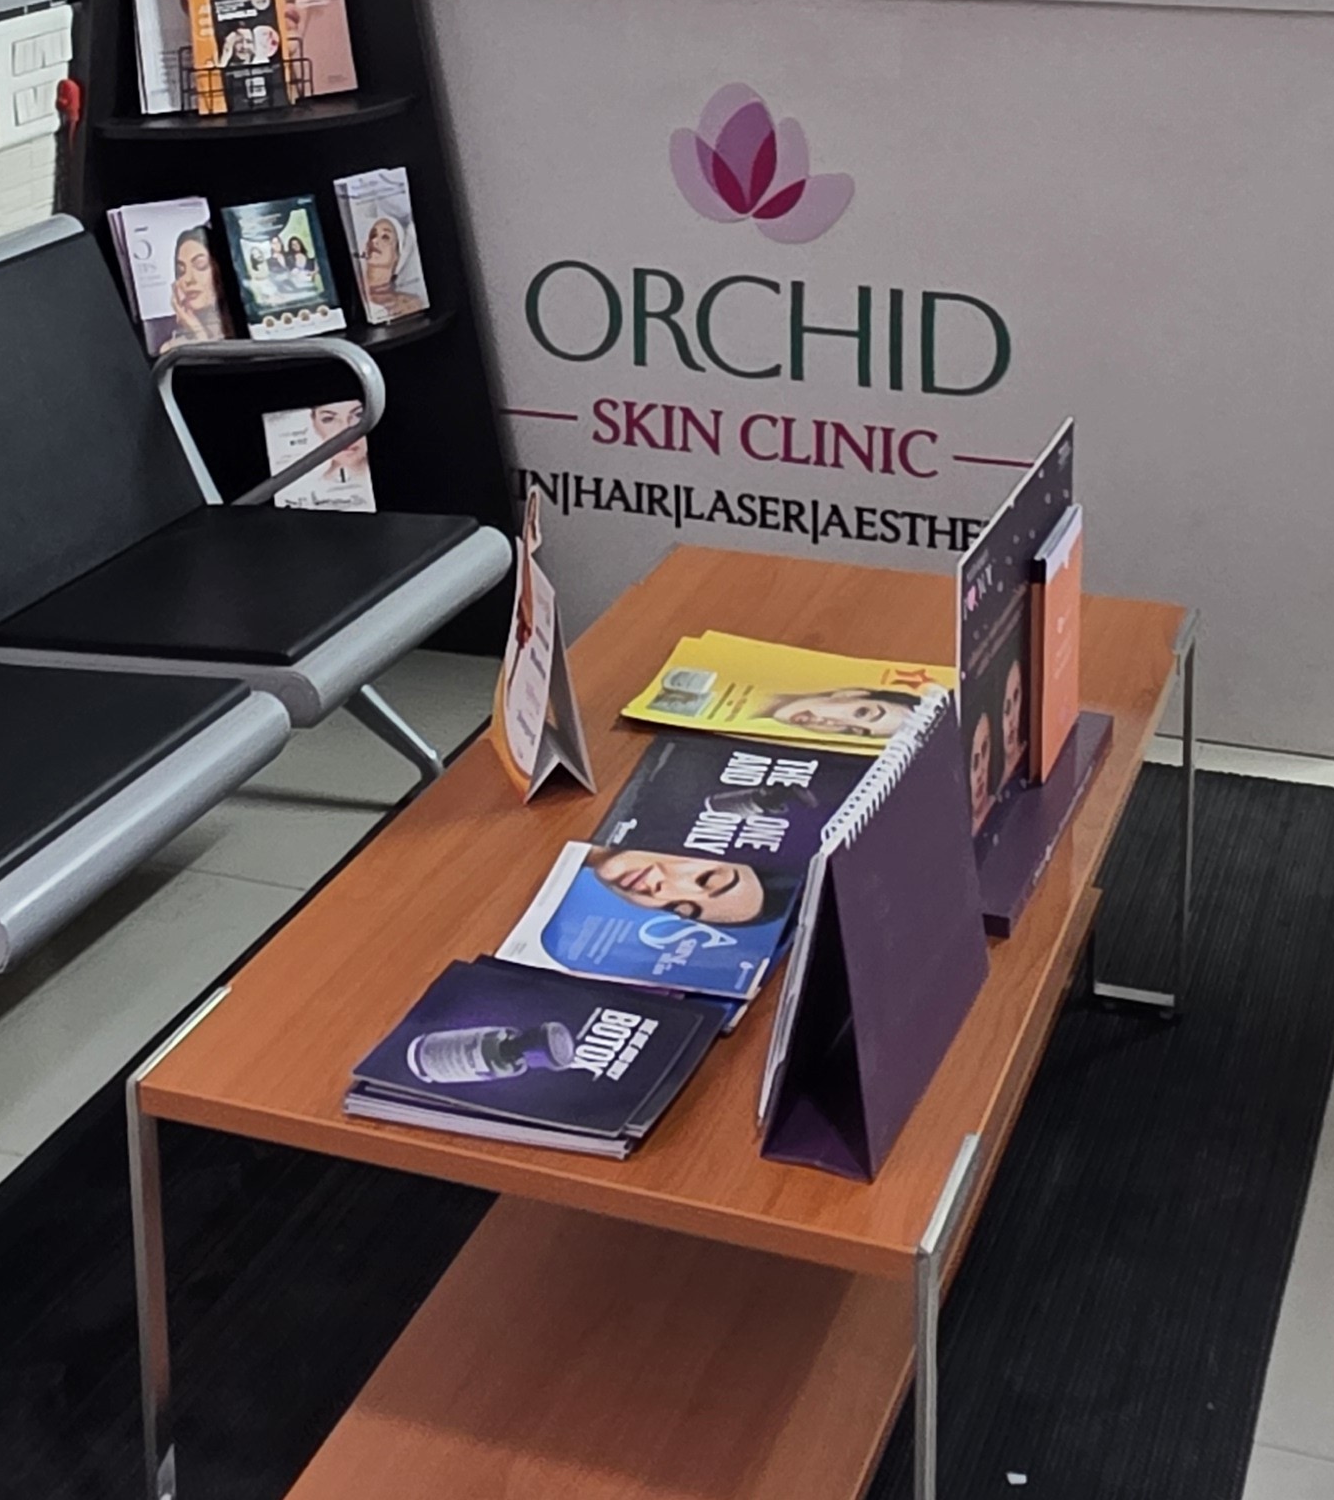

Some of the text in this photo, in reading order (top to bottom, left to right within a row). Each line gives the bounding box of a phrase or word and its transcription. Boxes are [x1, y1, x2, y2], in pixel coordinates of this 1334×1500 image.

[524, 259, 1011, 397] ORCHID
[592, 398, 939, 479] SKIN CLINIC
[720, 751, 773, 786] AND
[734, 759, 819, 852] THE ONE
[683, 811, 743, 855] ONLY
[571, 1008, 642, 1081] BOTOX
